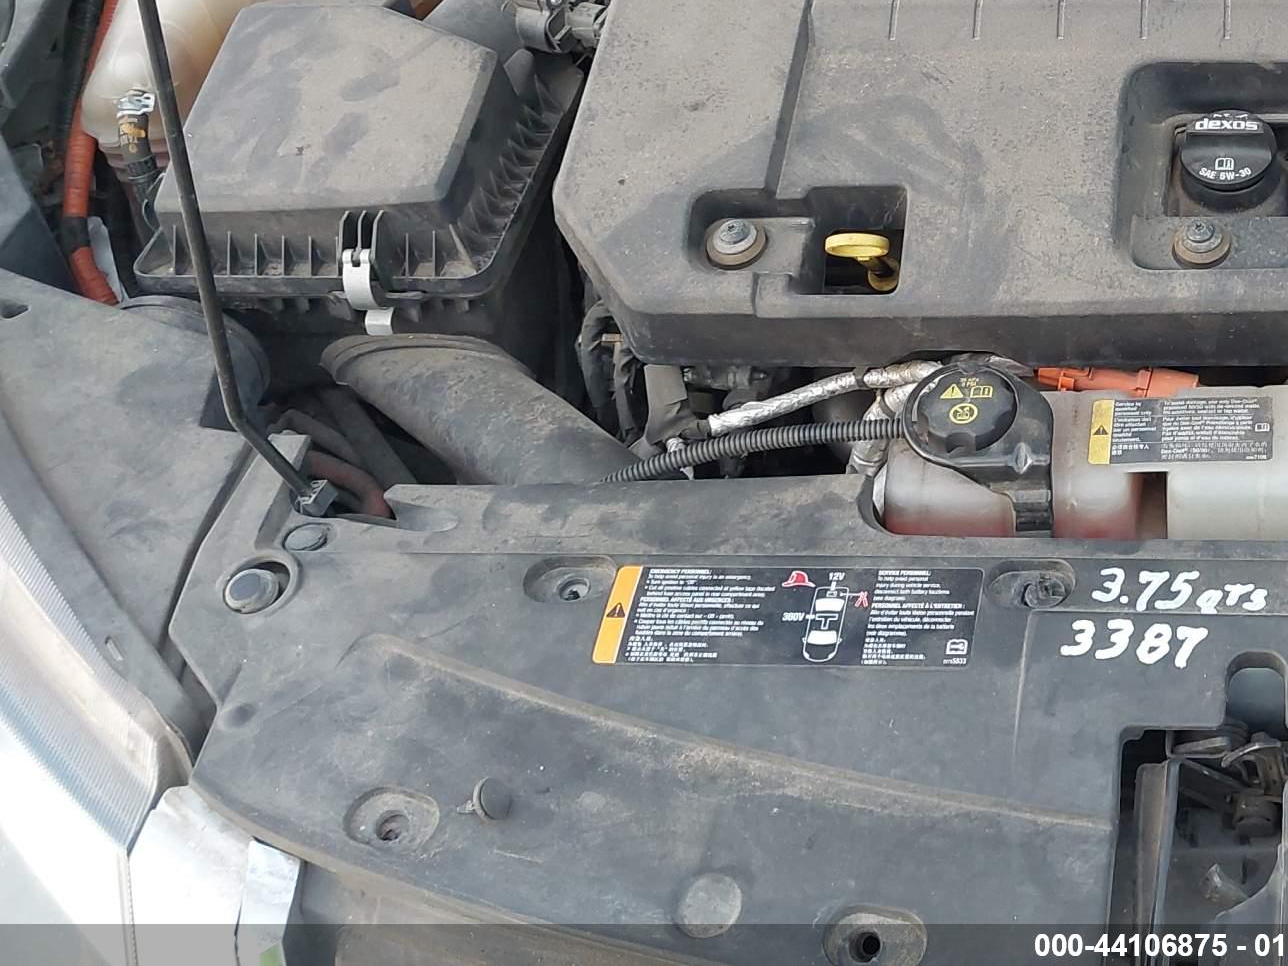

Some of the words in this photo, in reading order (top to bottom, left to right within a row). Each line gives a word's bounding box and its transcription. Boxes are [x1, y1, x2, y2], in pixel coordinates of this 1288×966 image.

[1195, 118, 1258, 131] dexos
[1199, 167, 1217, 180] SAE
[1219, 167, 1252, 181] 5W-30
[828, 572, 846, 581] 12V
[1060, 619, 1208, 669] 3387
